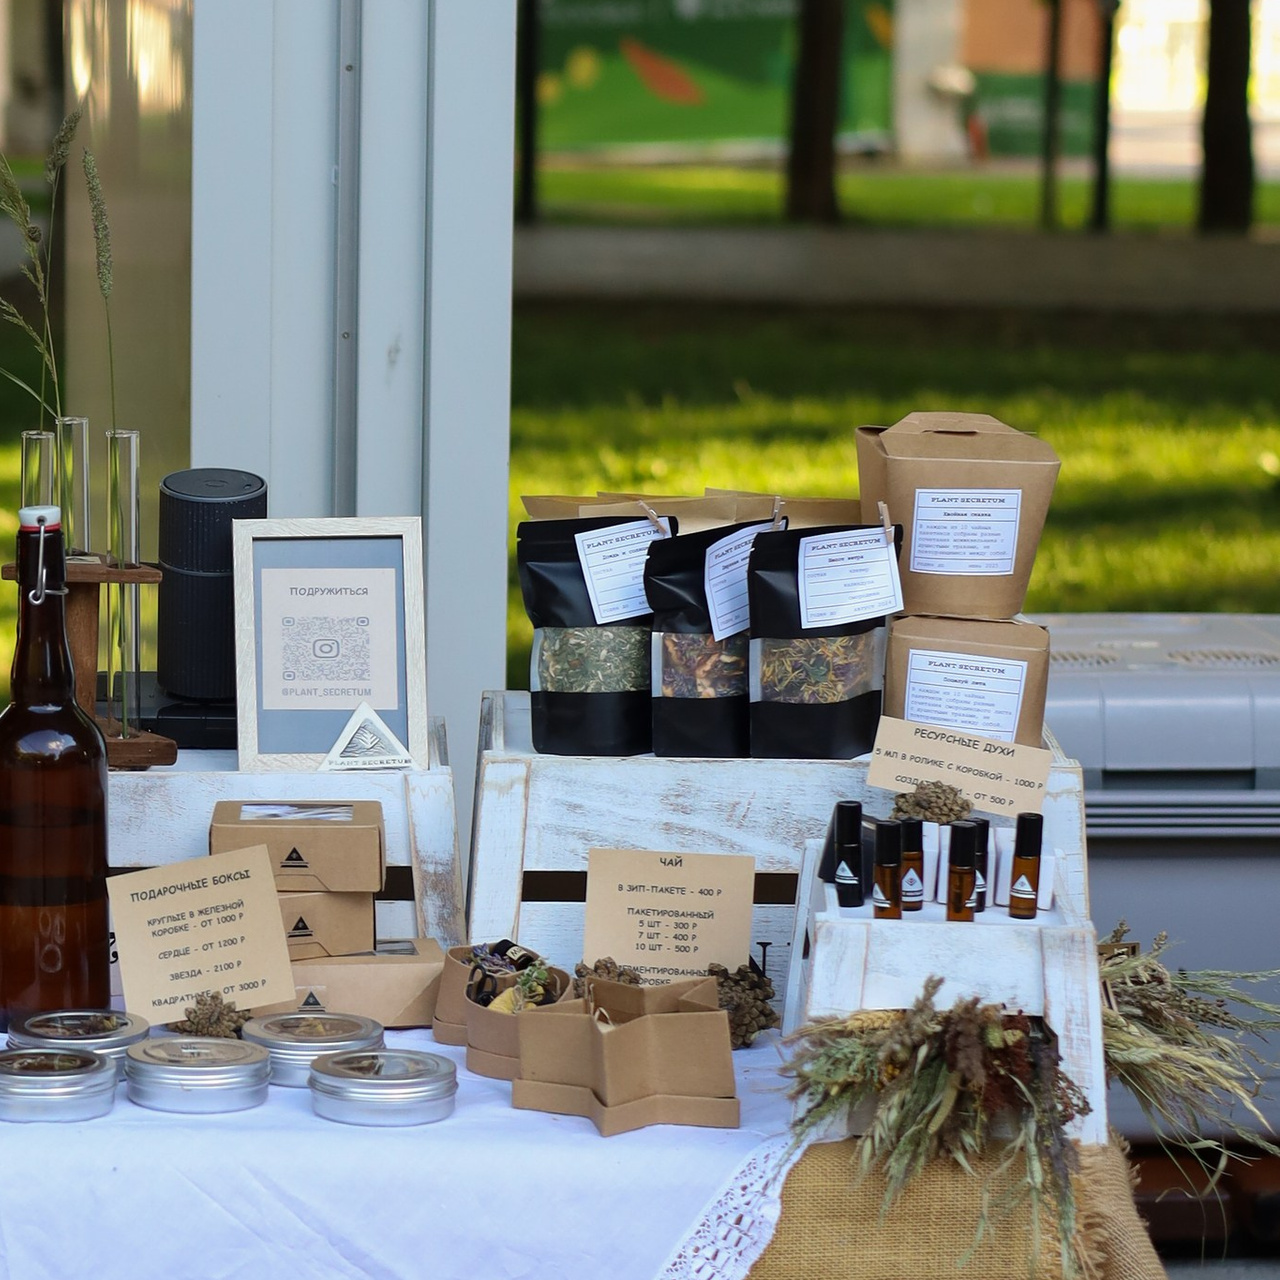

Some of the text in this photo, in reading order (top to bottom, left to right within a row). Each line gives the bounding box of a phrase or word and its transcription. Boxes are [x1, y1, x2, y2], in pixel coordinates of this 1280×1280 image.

[587, 540, 613, 549] PLANT
[290, 587, 368, 597] ПОДРУЖИТЬСЯ
[282, 688, 371, 697] @PLANT_SECRETUM
[914, 728, 1015, 757] РЕСУРСНЫЕ ДУХИ
[362, 758, 413, 766] SECRETUM
[884, 750, 898, 759] МЛ
[909, 755, 944, 768] РОЛИКЕ
[956, 764, 1002, 781] КОРОБКОЙ
[1014, 778, 1035, 788] 1000
[974, 792, 1006, 806] ОТ 500
[660, 856, 683, 867] ЧАЙ
[130, 870, 251, 902] ПОДАРОЧНЫЕ БОКСЫ
[627, 884, 686, 895] ЗИП-ПАКЕТЕ
[698, 888, 714, 896] 400
[147, 912, 186, 926] КРУГЛЫЕ
[197, 899, 244, 916] ЖЕЛЕЗНОЙ
[627, 908, 714, 919] ПАКЕТИРОВАННЫЙ
[152, 914, 236, 938] КОРОБКЕ ОТ 1000
[673, 933, 688, 941] 400
[158, 938, 238, 960] СЕРДЦЕ ОТ 1200
[170, 962, 234, 981] ЗВЕЗДА 2100
[152, 981, 259, 1007] КВАДРАТНЫЕ ОТ 3000
